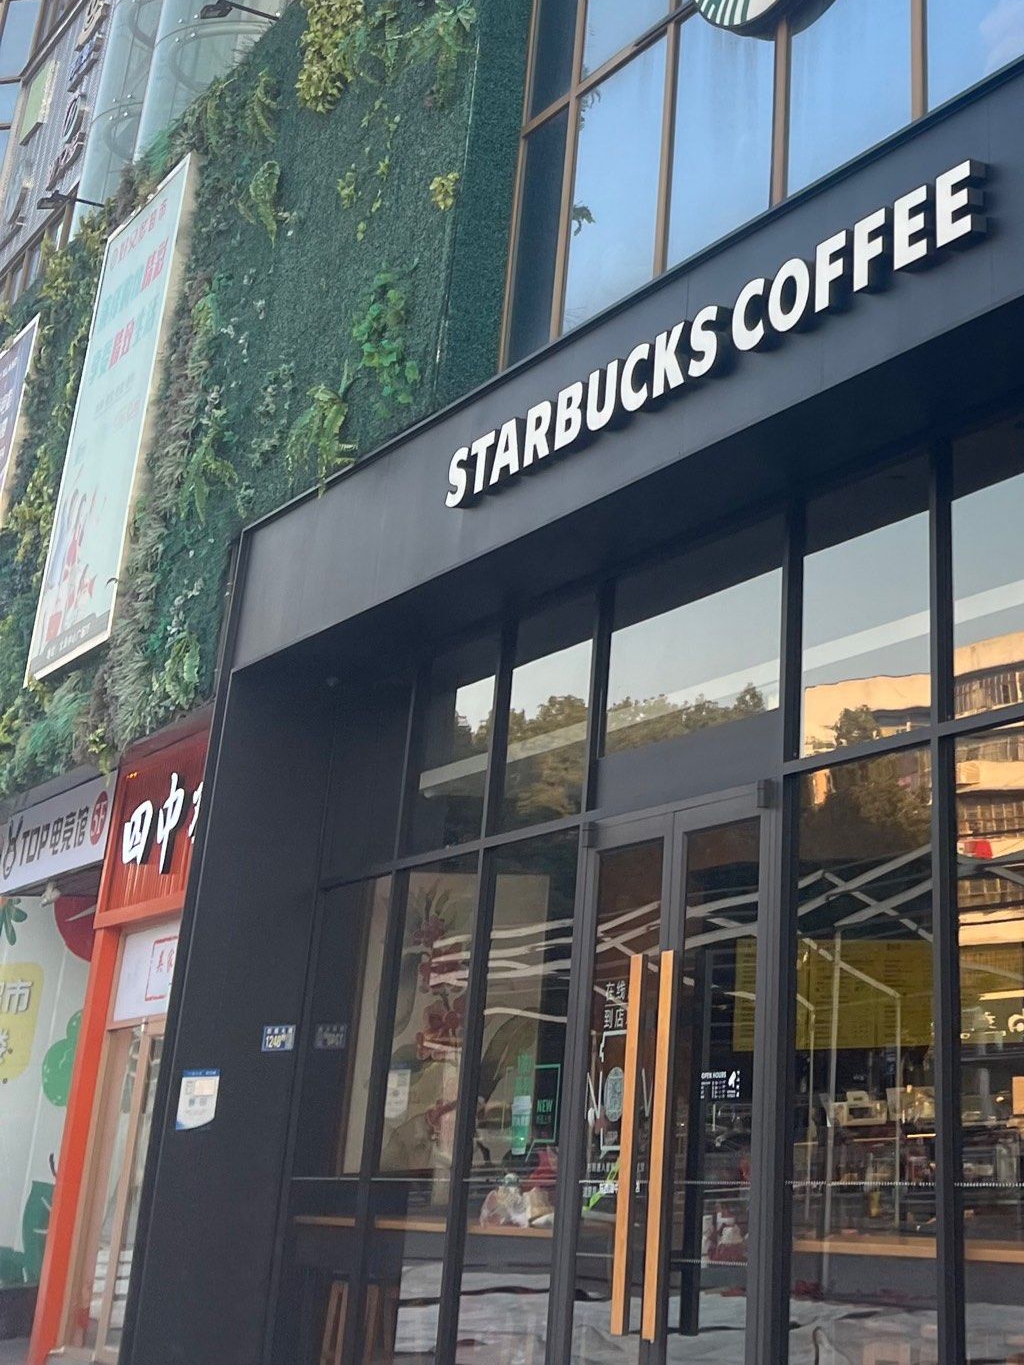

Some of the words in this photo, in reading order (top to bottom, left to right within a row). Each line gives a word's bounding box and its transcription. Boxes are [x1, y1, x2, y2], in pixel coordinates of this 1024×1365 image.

[445, 304, 719, 509] STARBUCKS
[730, 158, 977, 352] COFFEE
[605, 980, 629, 1002] 在线
[603, 1007, 628, 1029] 到店
